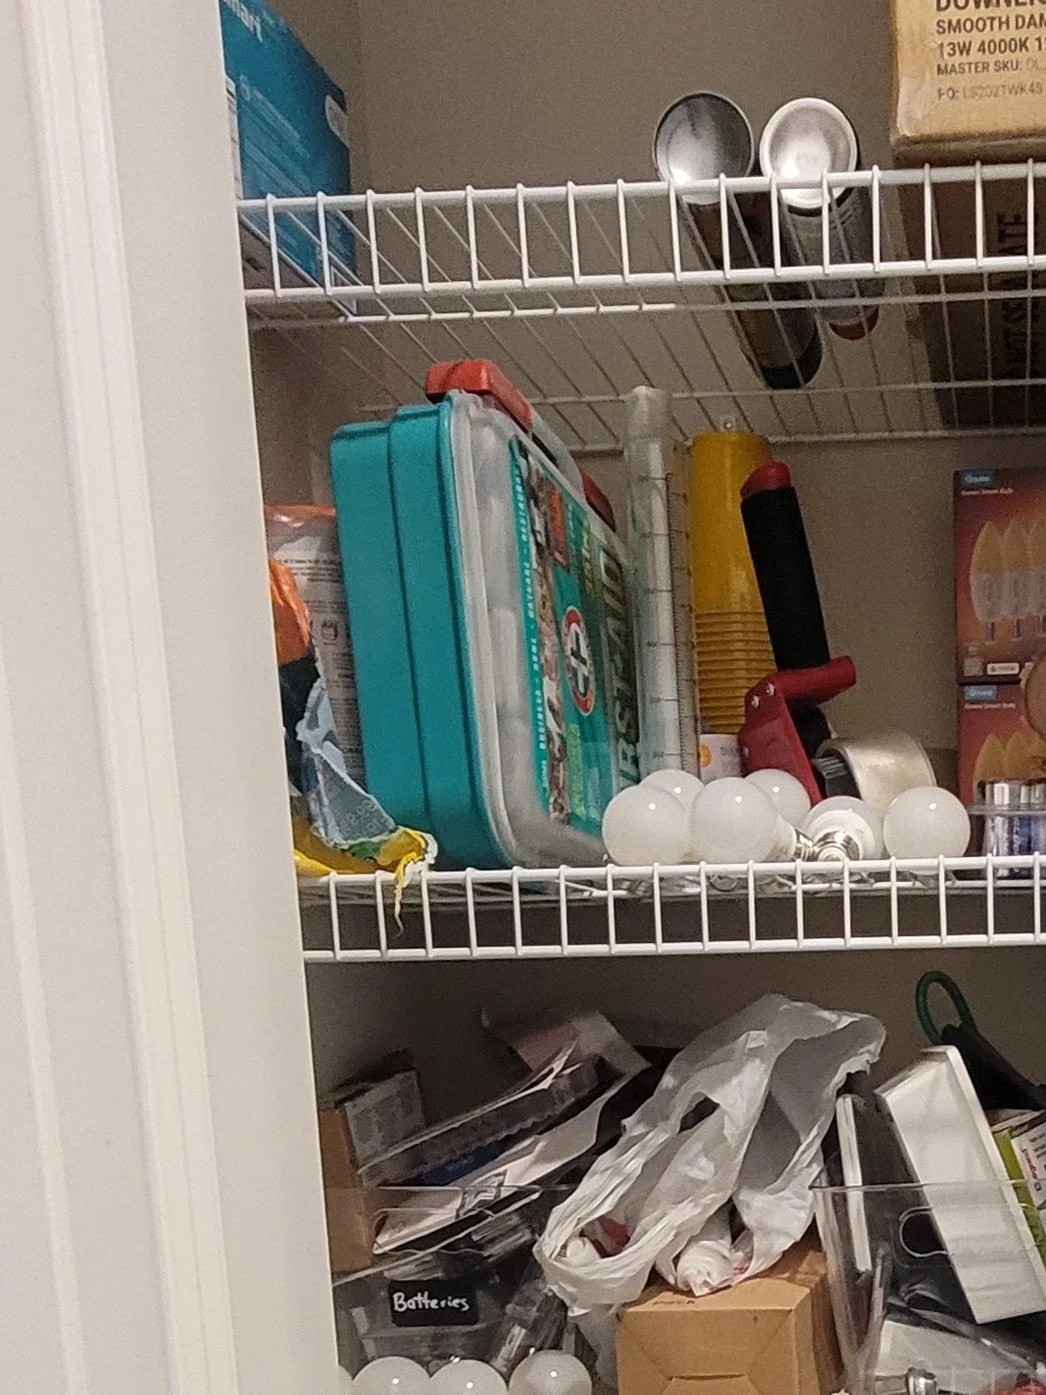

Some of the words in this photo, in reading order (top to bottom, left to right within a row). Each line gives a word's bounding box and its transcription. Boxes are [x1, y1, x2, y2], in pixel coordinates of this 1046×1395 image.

[936, 17, 1011, 35] SMOOTH
[937, 41, 972, 59] 13W
[977, 37, 1030, 55] 4000K
[936, 61, 990, 76] MASTER
[993, 59, 1023, 74] SKU:
[392, 1291, 471, 1312] Batteries
